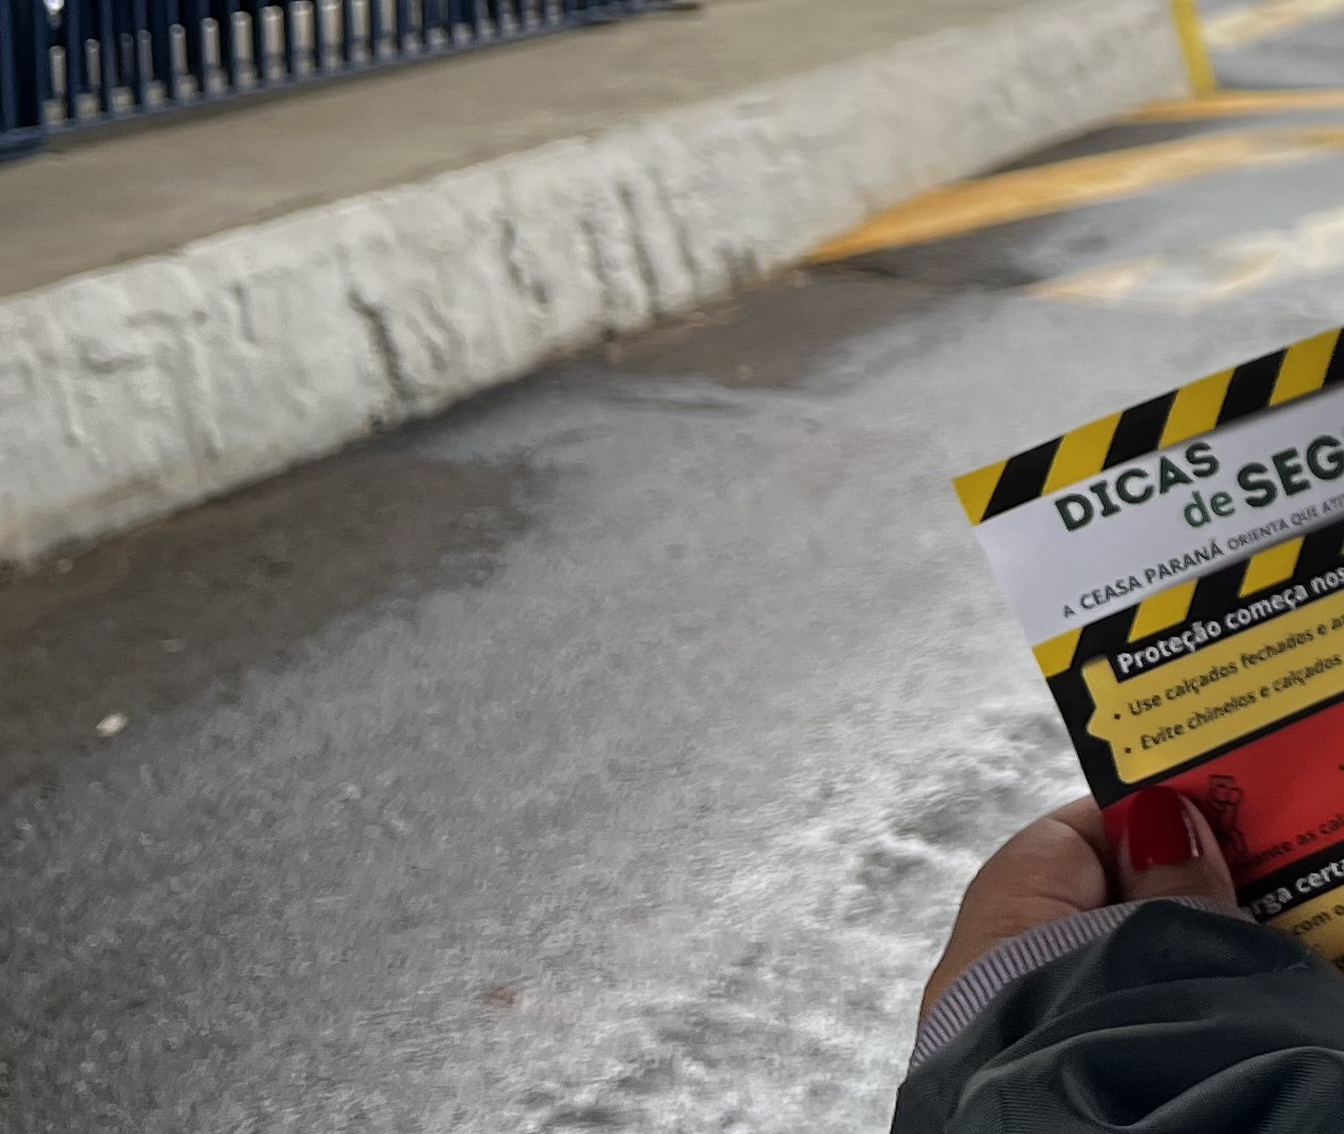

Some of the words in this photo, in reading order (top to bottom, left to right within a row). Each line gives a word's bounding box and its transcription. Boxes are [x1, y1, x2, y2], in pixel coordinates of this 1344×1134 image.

[1053, 439, 1221, 531] DICAS
[1179, 486, 1237, 529] de
[1061, 603, 1076, 619] A
[1078, 574, 1143, 610] CEASA
[1142, 538, 1224, 584] PARANÁ
[1226, 517, 1290, 551] ORIENTA
[1289, 505, 1320, 527] QUE
[1115, 617, 1223, 675] Proteção
[1223, 583, 1309, 631] começa
[1126, 692, 1162, 717] Use
[1163, 659, 1240, 702] calçados
[1238, 627, 1314, 668] fechados
[1315, 622, 1327, 636] e
[1138, 722, 1185, 751] Evite
[1258, 685, 1270, 698] e
[1271, 652, 1344, 694] calçados
[1294, 829, 1319, 847] as
